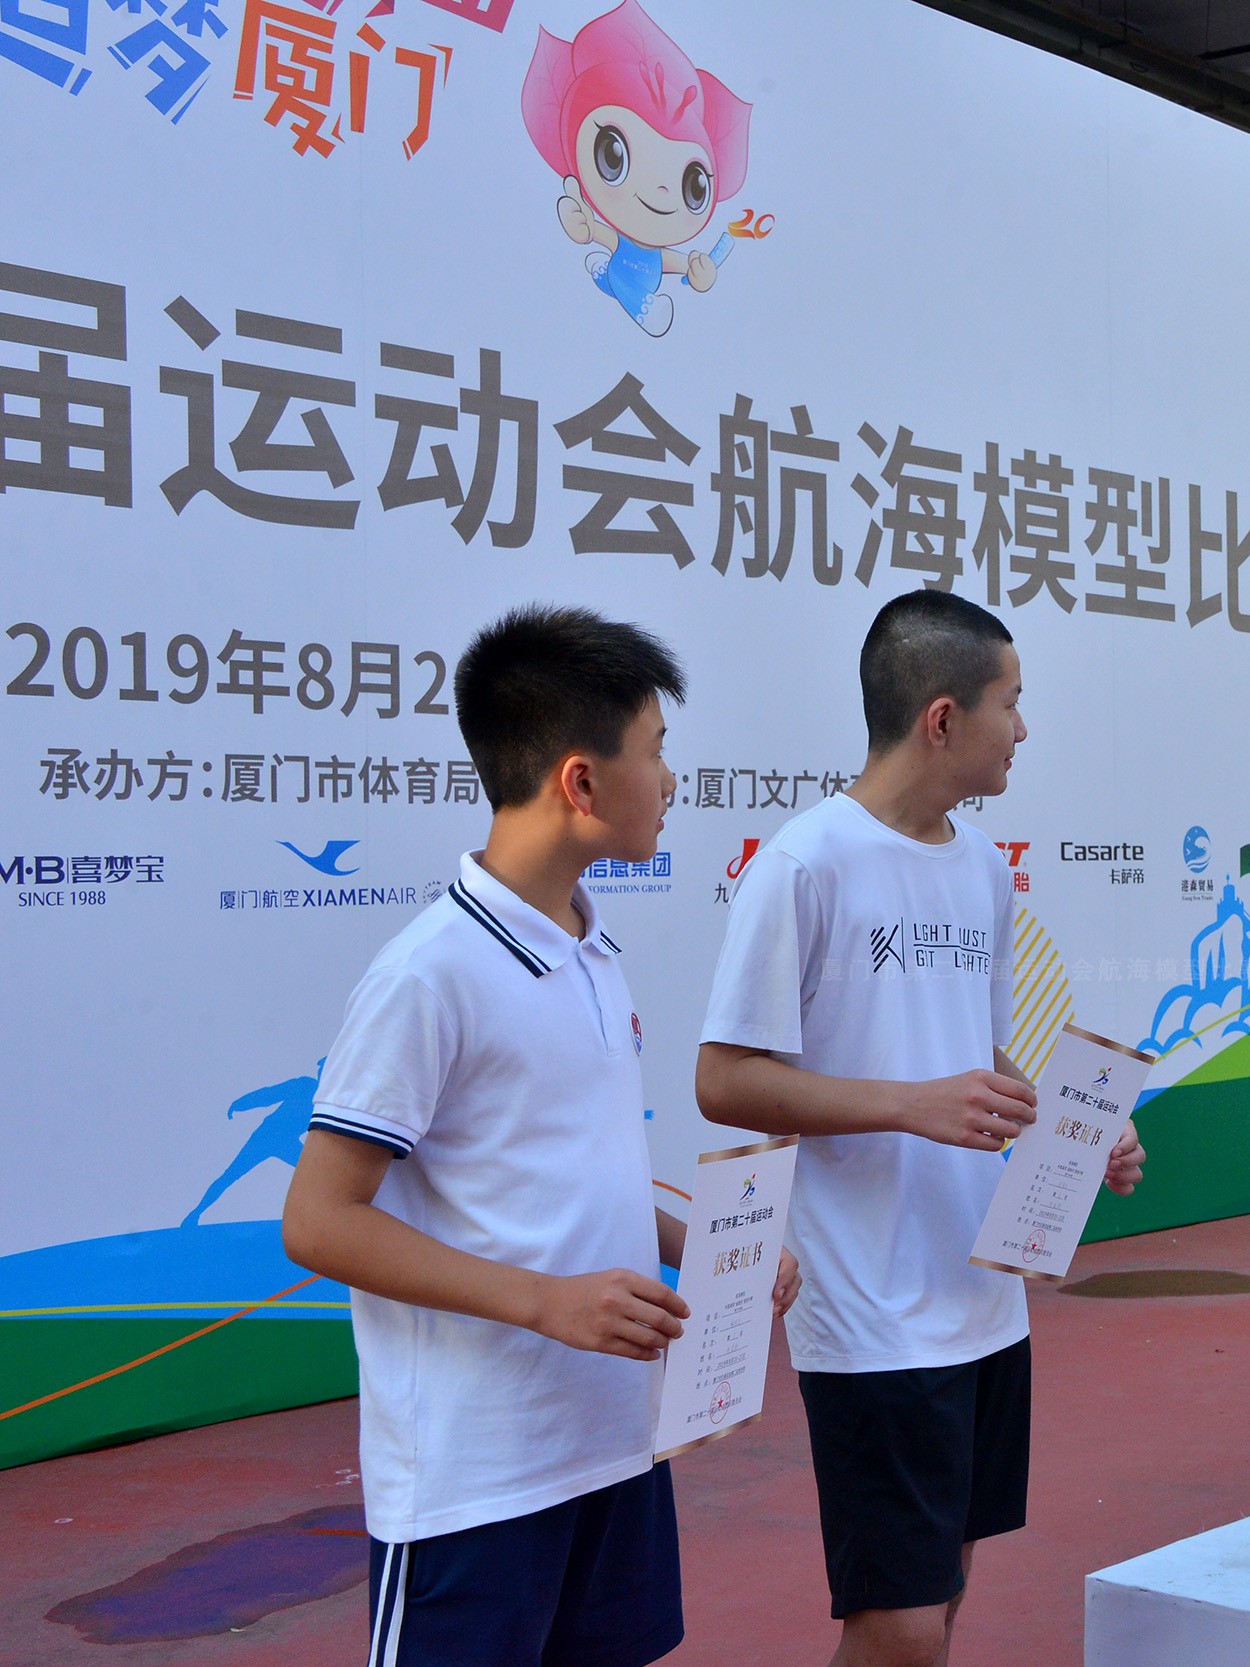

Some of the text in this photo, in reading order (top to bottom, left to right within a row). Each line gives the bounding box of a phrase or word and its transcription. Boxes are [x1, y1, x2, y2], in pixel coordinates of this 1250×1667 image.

[1060, 841, 1145, 862] Casarte
[71, 855, 165, 884] 喜梦宝
[1109, 868, 1145, 885] 卡萨帝
[18, 890, 107, 907] SINCE 1988
[641, 884, 672, 893] GROUP
[1059, 1085, 1119, 1115] 厦门市第二十届运动会
[1055, 1115, 1103, 1146] 获奖证书
[709, 1205, 774, 1234] 厦门市第二十届运动会
[713, 1241, 763, 1278] 获奖证书
